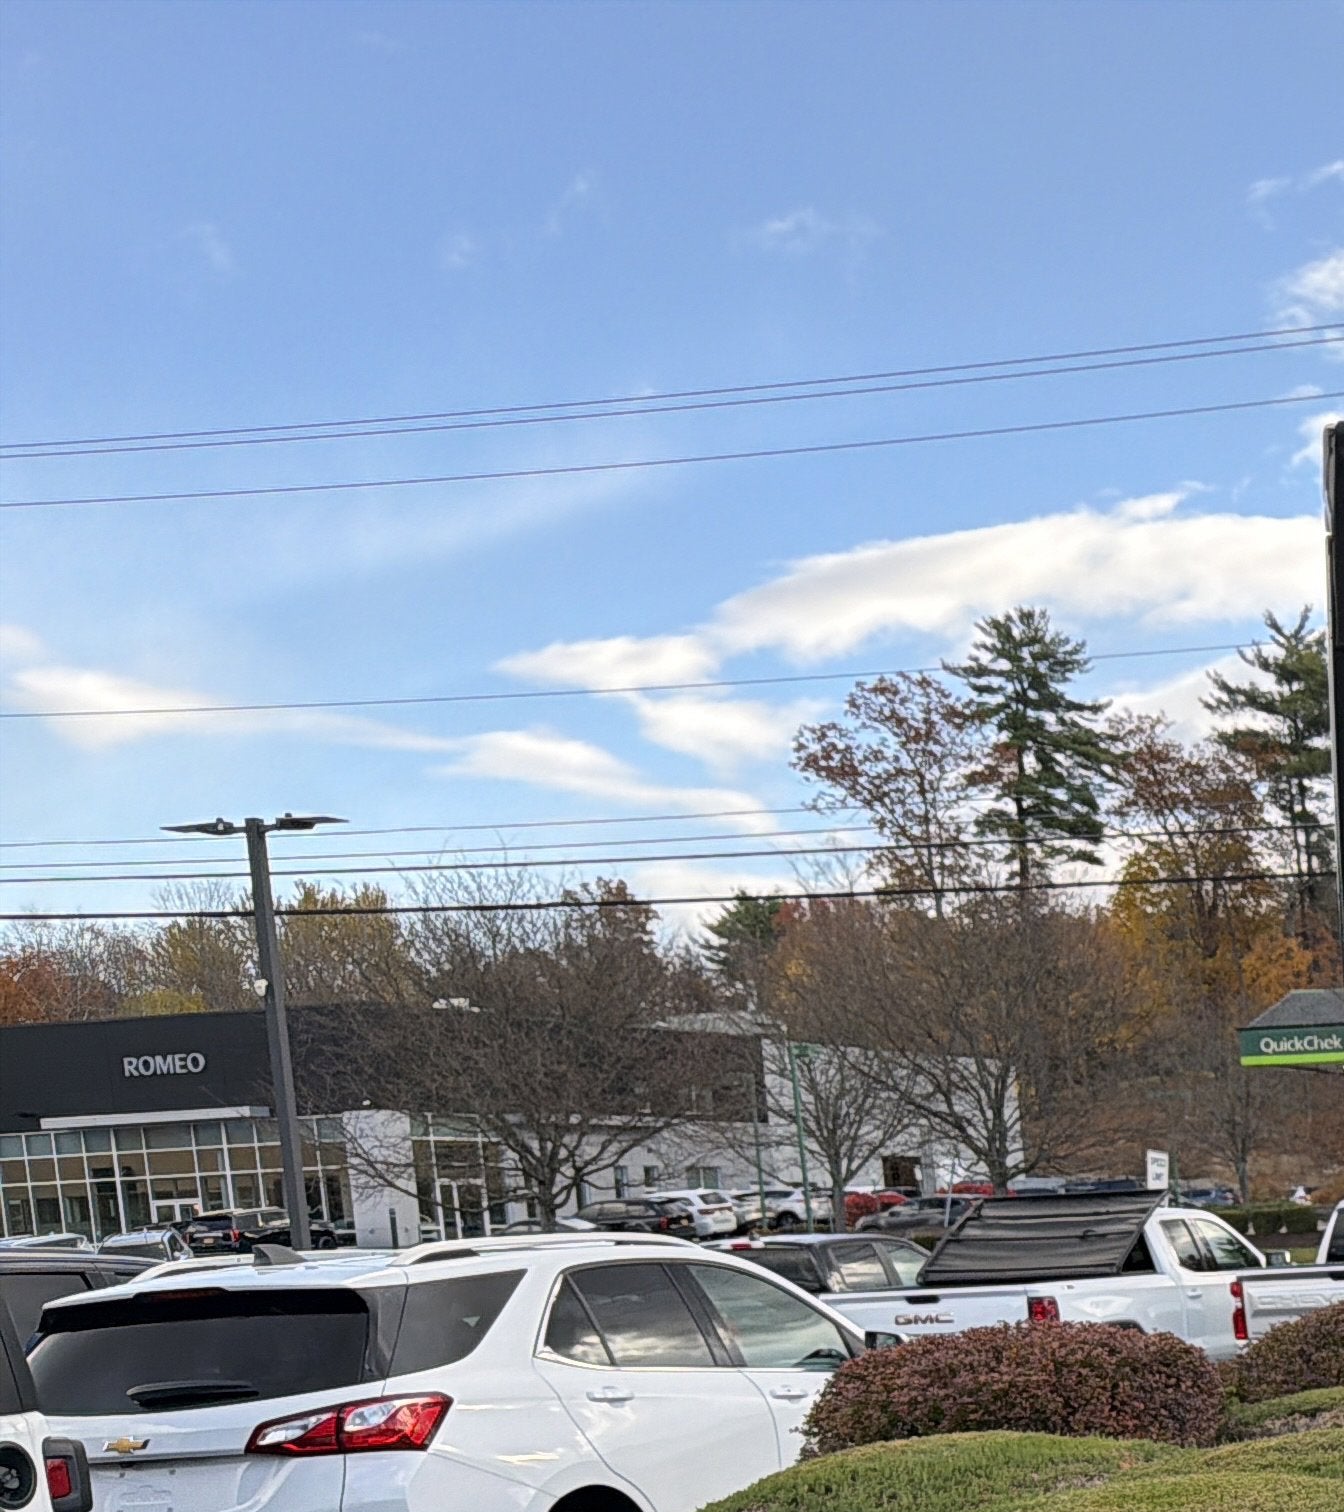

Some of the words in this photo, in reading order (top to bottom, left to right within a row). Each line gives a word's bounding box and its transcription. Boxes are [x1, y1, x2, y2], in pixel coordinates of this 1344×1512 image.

[1259, 1034, 1343, 1054] QuickChek
[122, 1052, 206, 1078] ROMEO
[894, 1313, 955, 1326] GMC
